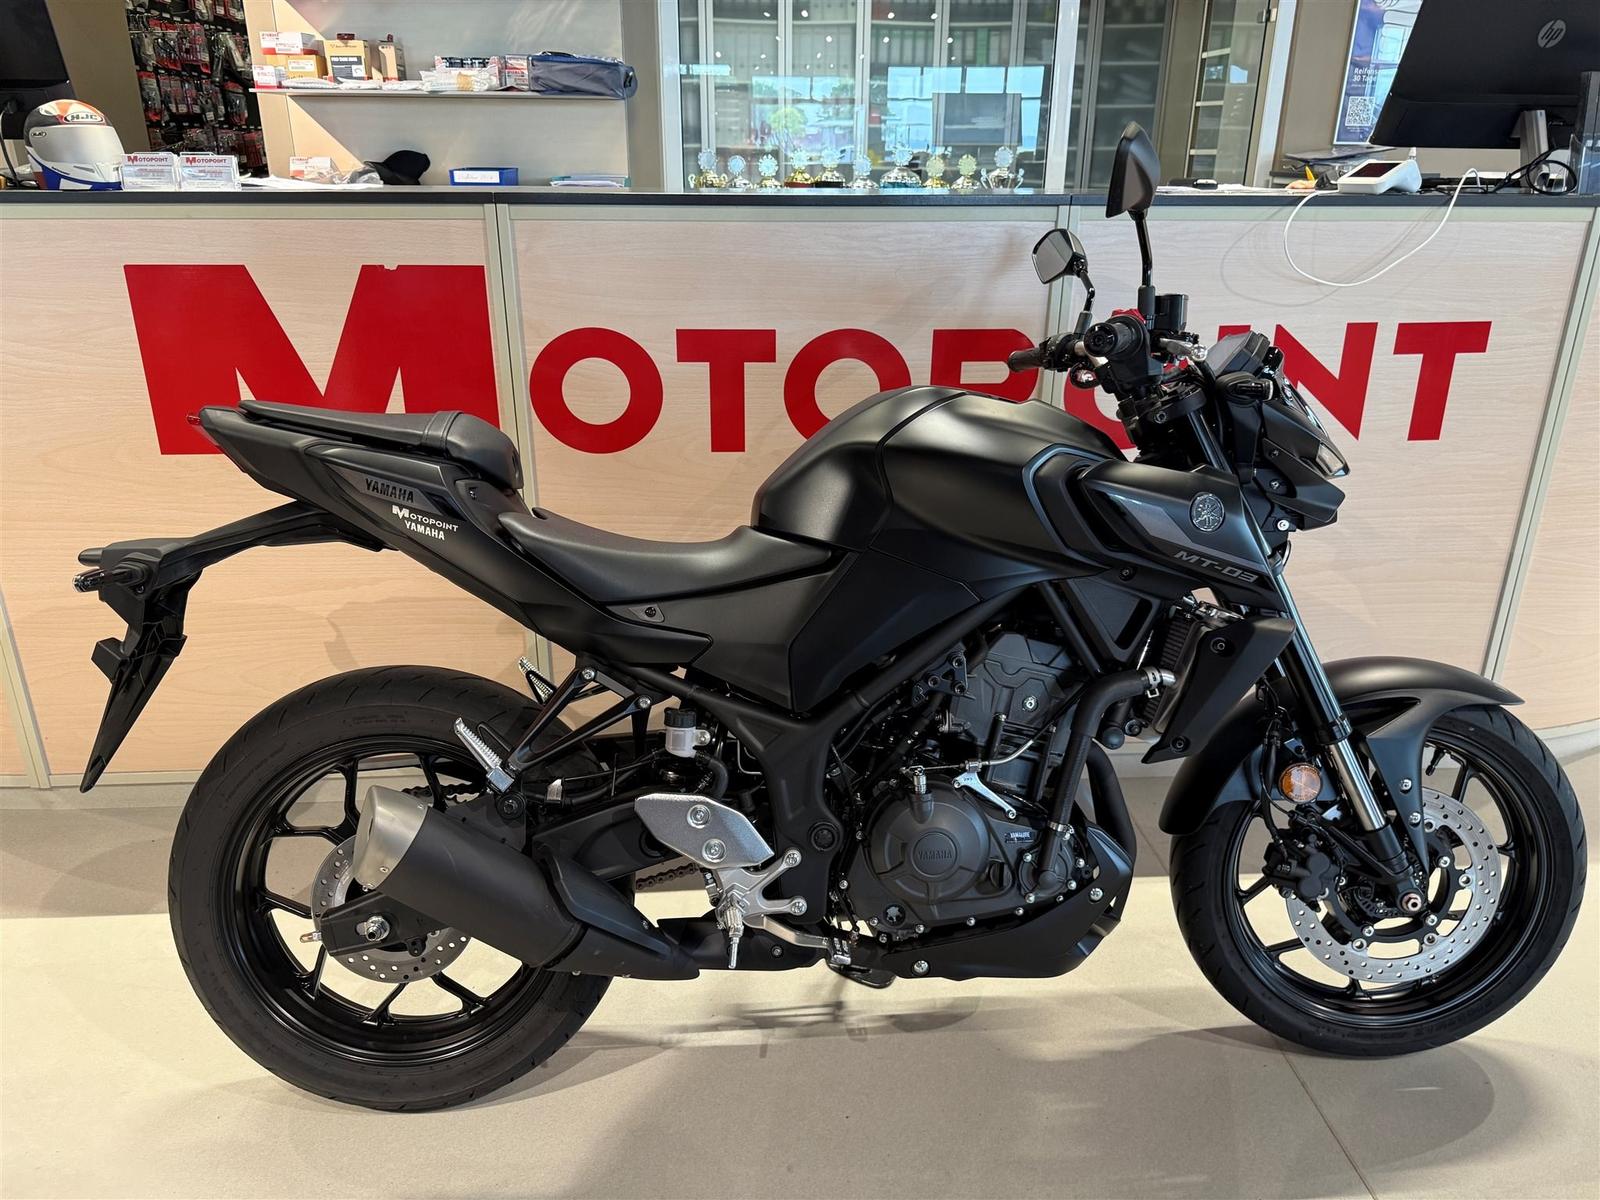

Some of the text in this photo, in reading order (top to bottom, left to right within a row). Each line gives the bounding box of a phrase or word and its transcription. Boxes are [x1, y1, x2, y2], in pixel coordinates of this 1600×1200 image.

[1538, 20, 1566, 48] hp
[70, 113, 98, 121] HJC
[127, 155, 168, 164] MOTOPOINT
[186, 156, 227, 166] MOTOPOINT
[124, 264, 1492, 456] MOTOPNT
[365, 478, 414, 503] YAMAHA
[392, 504, 459, 532] MOTOPOINT
[404, 519, 445, 540] YAMAHA
[1174, 550, 1259, 583] MT-03
[918, 850, 952, 860] YAMAHA
